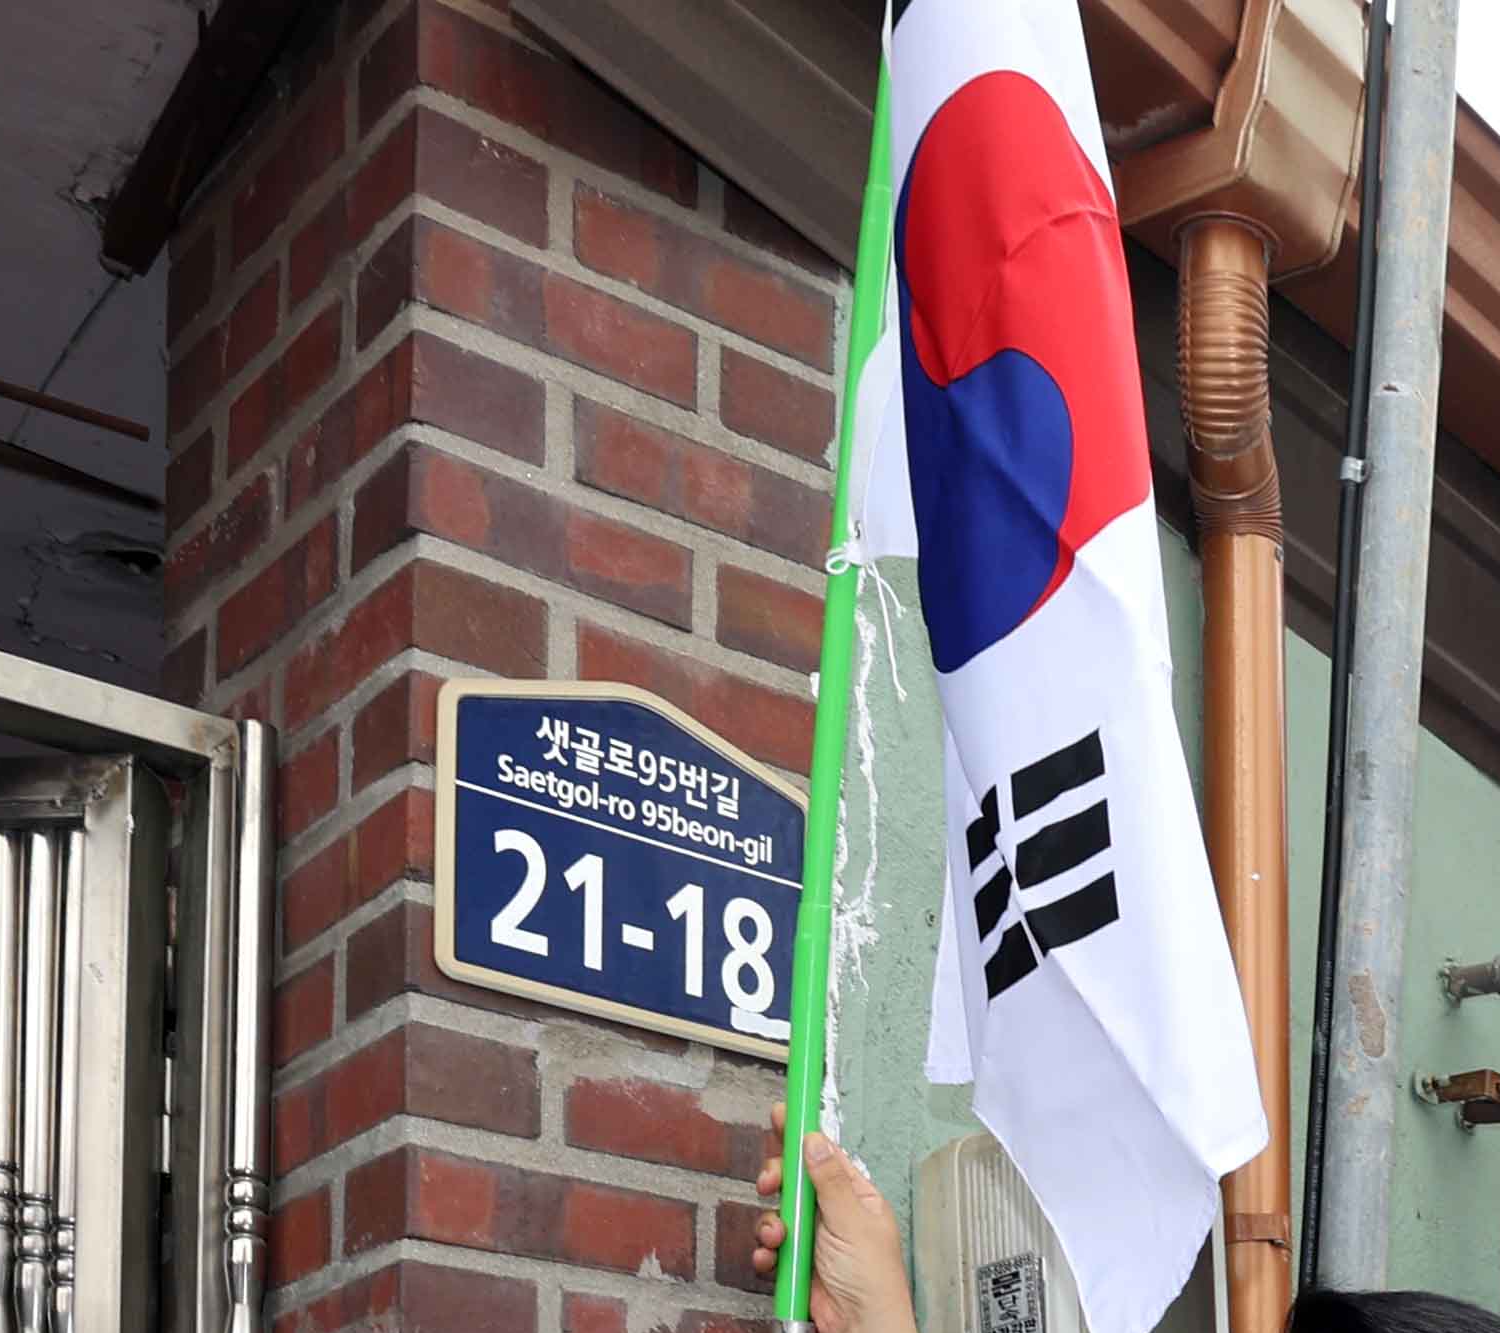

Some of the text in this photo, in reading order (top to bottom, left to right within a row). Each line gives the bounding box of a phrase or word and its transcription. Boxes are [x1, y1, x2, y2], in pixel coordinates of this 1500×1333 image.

[498, 755, 773, 865] Saetgol-ro 95beon-gil
[536, 715, 740, 820] 샛골로95번길
[490, 828, 776, 1014] 21-18
